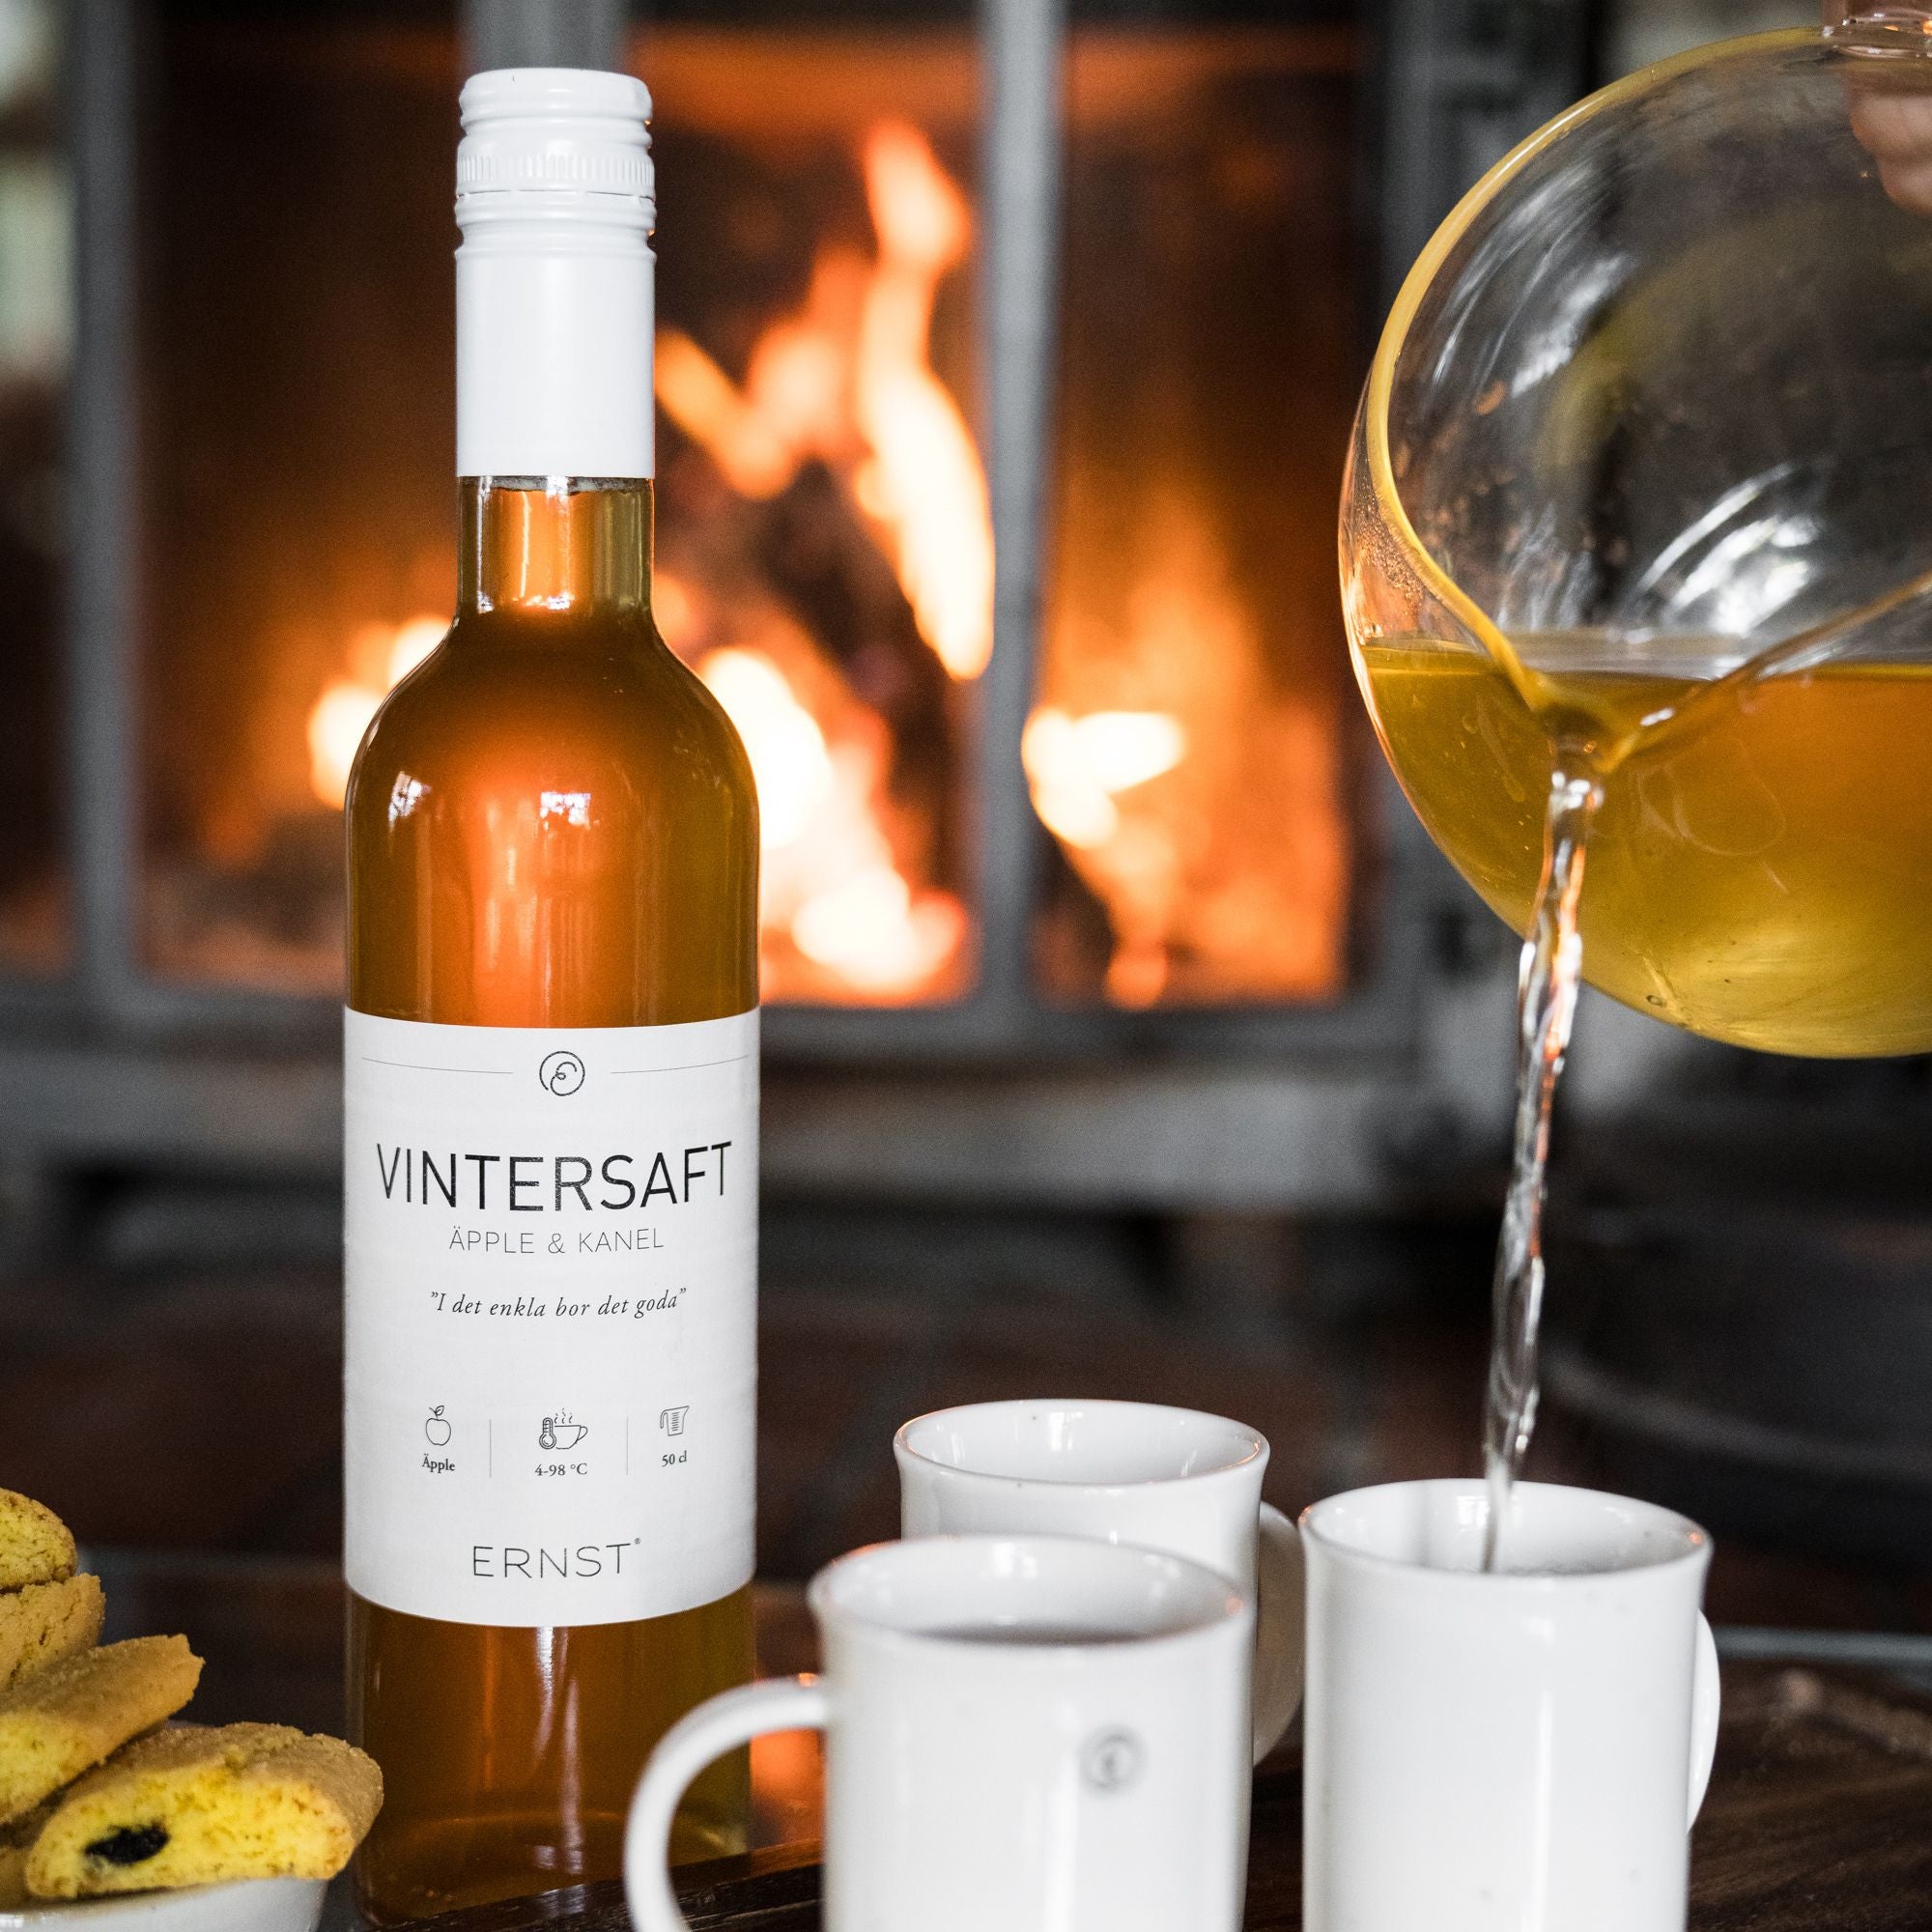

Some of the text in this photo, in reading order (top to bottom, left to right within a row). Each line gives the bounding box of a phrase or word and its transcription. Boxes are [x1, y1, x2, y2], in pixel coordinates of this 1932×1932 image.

[376, 1141, 733, 1211] VINTERSAFT
[448, 1225, 665, 1255] ÄPPLE & KANEL
[451, 1293, 483, 1315] det
[489, 1296, 547, 1318] enkla
[555, 1296, 591, 1317] bor
[597, 1293, 630, 1316] det
[421, 1452, 456, 1474] Äpple
[534, 1463, 588, 1477] 4-98 °C
[661, 1453, 676, 1467] 50
